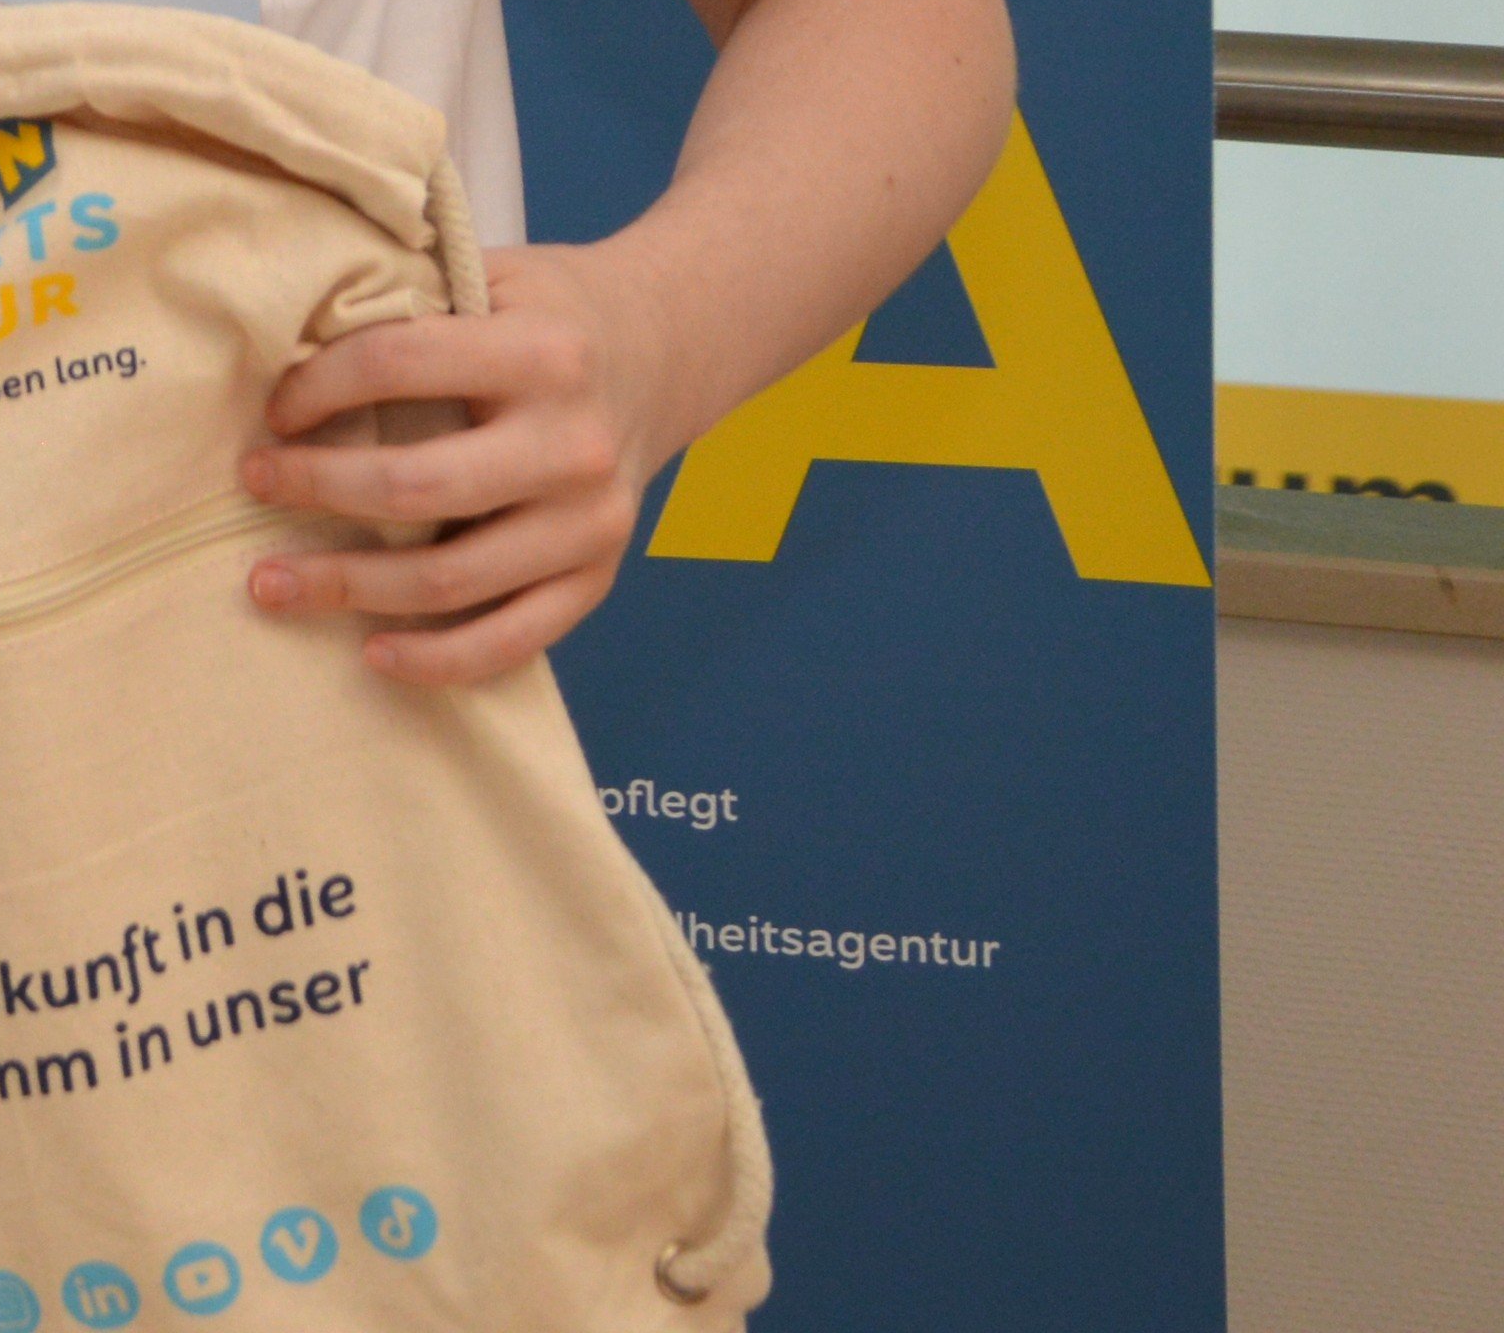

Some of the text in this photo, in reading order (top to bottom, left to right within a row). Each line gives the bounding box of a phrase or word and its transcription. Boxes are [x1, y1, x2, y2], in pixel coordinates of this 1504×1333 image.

[54, 343, 150, 385] lang.
[171, 901, 238, 963] in
[252, 867, 358, 939] die
[118, 1021, 174, 1081] in
[186, 957, 372, 1049] unser
